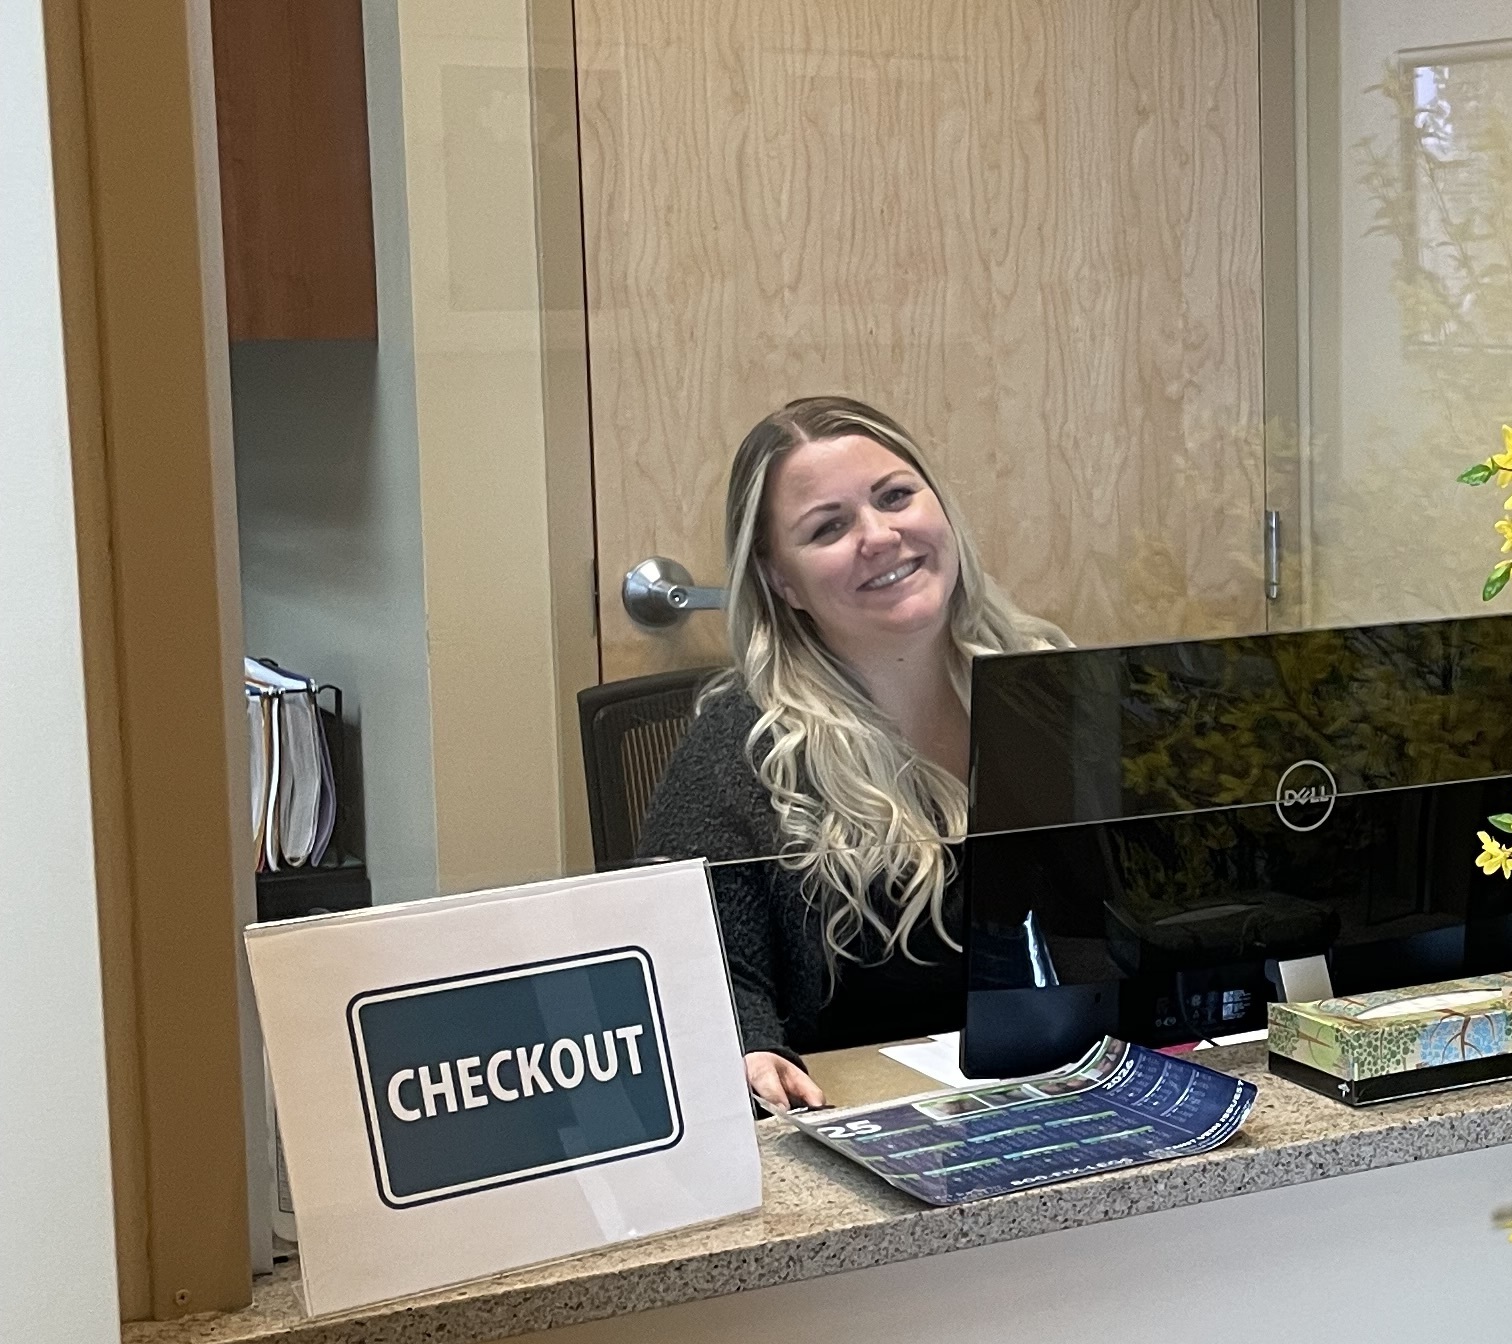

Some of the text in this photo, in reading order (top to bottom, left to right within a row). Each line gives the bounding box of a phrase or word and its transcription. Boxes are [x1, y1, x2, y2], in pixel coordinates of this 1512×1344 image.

[1284, 785, 1329, 806] DELL
[387, 1024, 644, 1122] CHECKOUT
[1102, 1059, 1135, 1091] 2026
